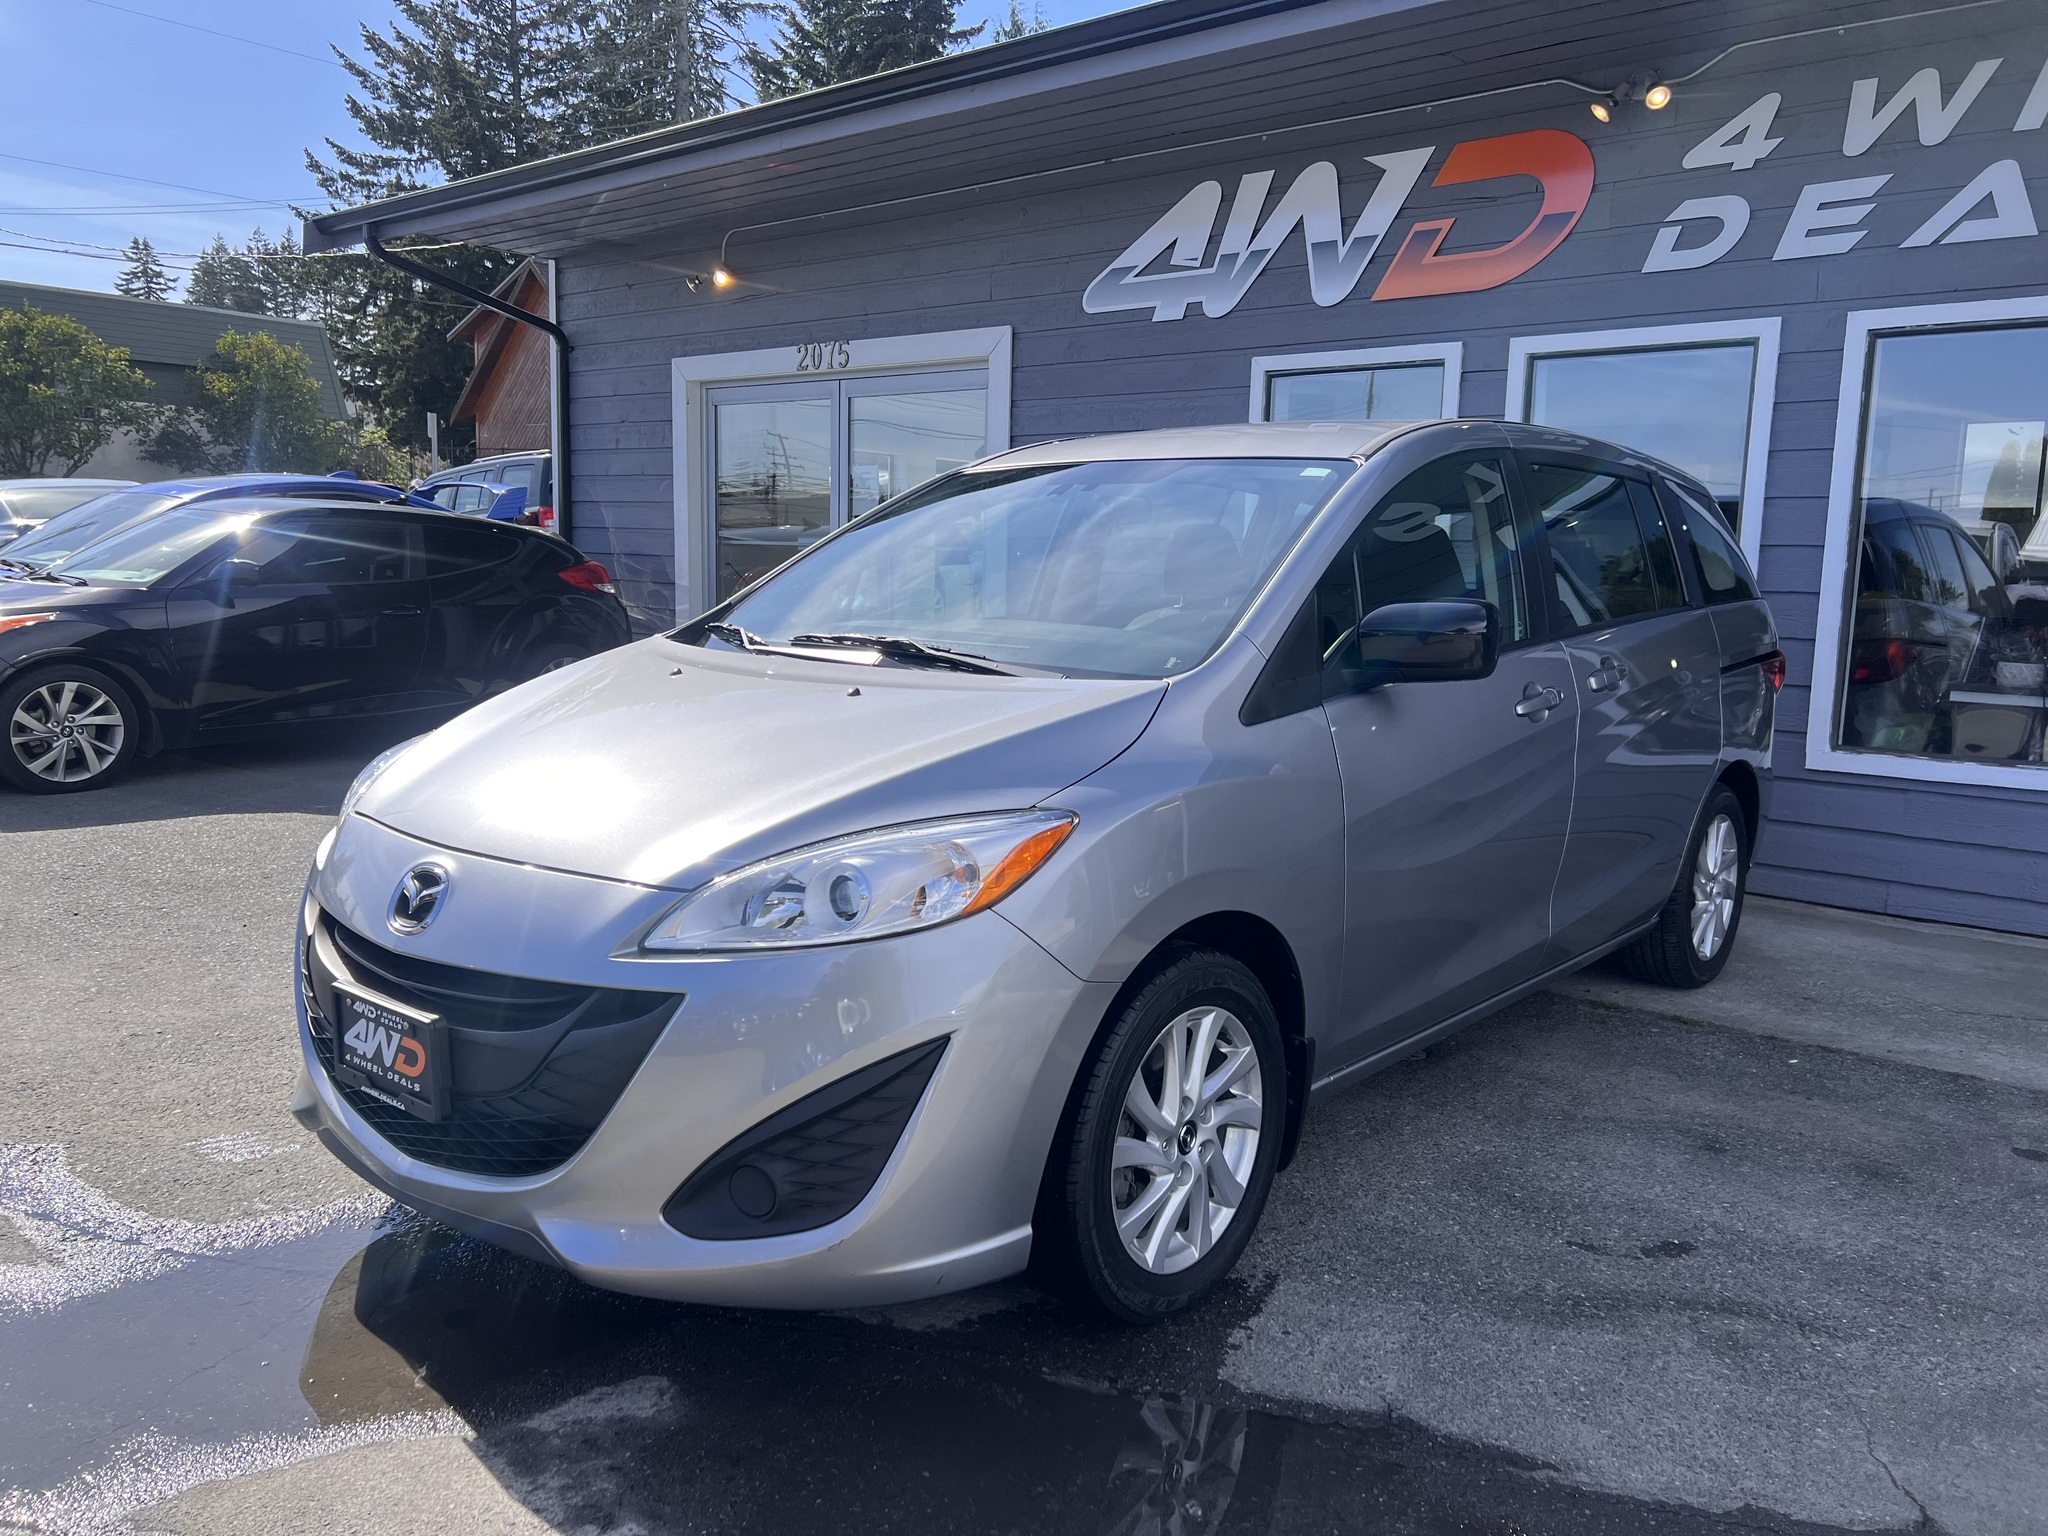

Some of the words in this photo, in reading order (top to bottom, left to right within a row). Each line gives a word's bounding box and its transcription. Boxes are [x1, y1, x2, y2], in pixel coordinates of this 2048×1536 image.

[1681, 91, 1785, 172] 4
[1082, 128, 1596, 323] 4WD
[796, 339, 850, 372] 2075
[352, 1000, 377, 1019] 4WD
[382, 1011, 404, 1024] WHEEL
[380, 1017, 403, 1030] DEALS
[343, 1017, 427, 1078] 4WD
[344, 1053, 351, 1061] 4
[353, 1055, 384, 1076] WHEEL
[386, 1071, 421, 1092] DEALS
